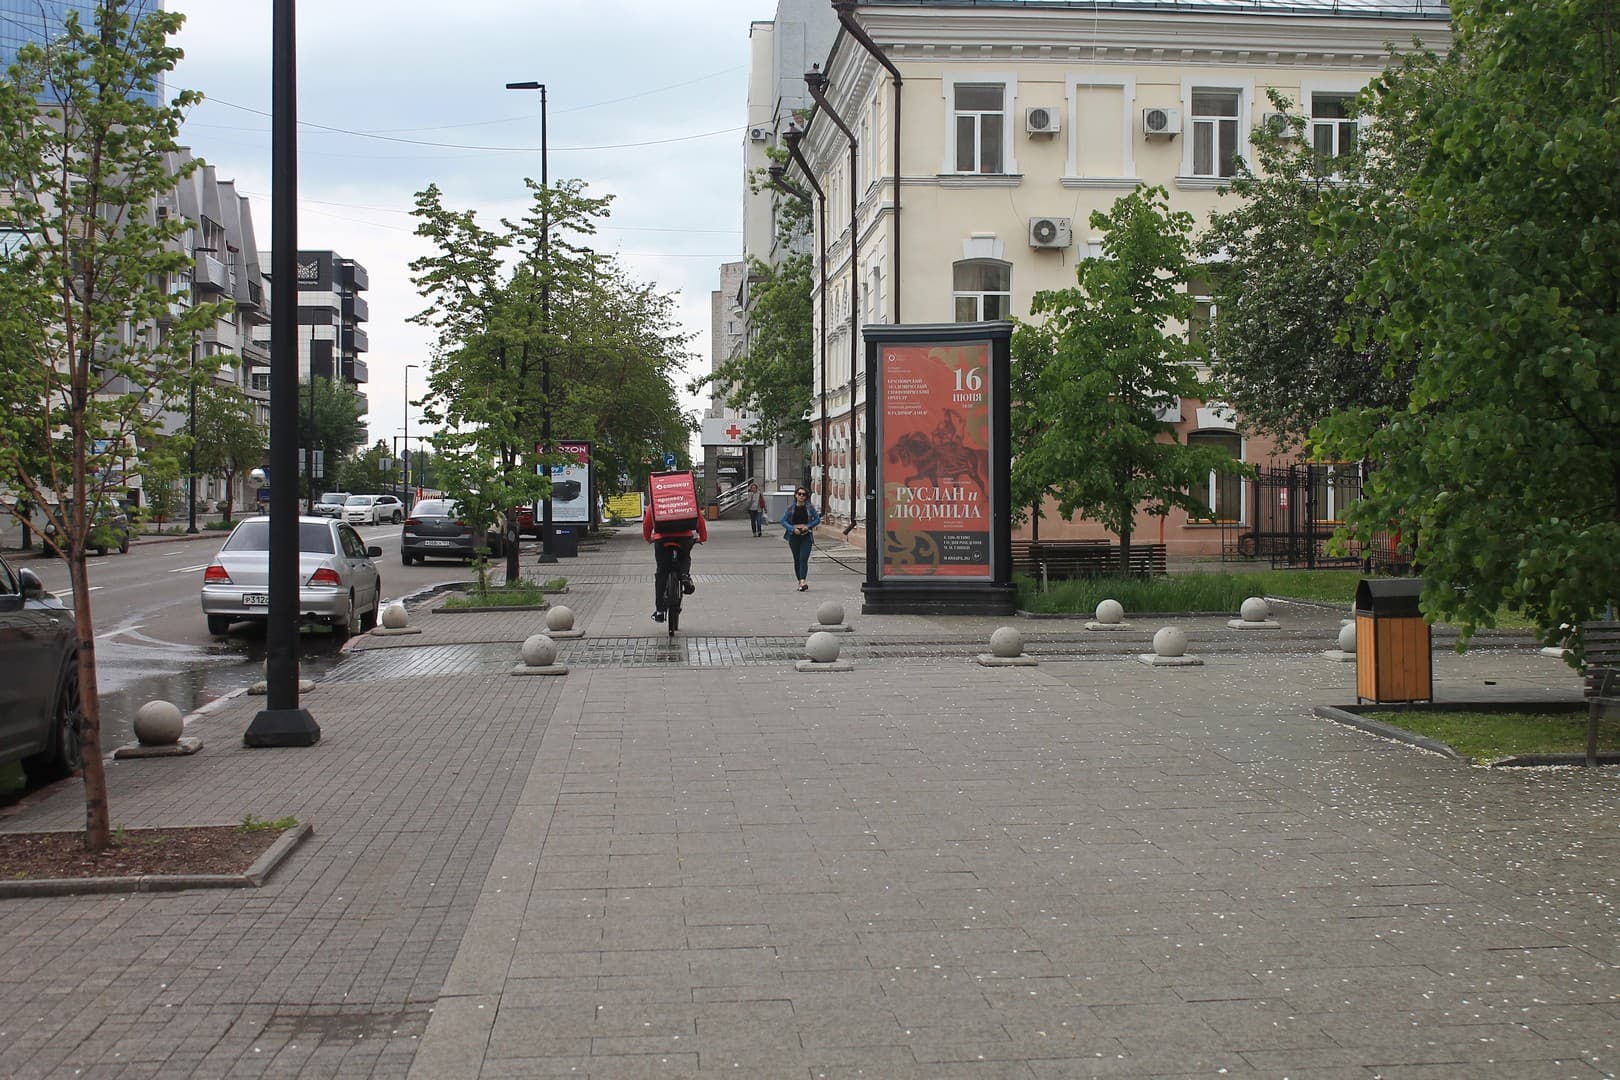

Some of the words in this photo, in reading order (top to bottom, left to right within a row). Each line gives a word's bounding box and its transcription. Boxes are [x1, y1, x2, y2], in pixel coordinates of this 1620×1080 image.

[953, 367, 982, 391] 16
[952, 392, 982, 402] ИЮНЯ
[896, 487, 965, 502] РУСЛАН
[968, 492, 978, 502] и
[889, 504, 982, 521] ЛЮДМИЛА
